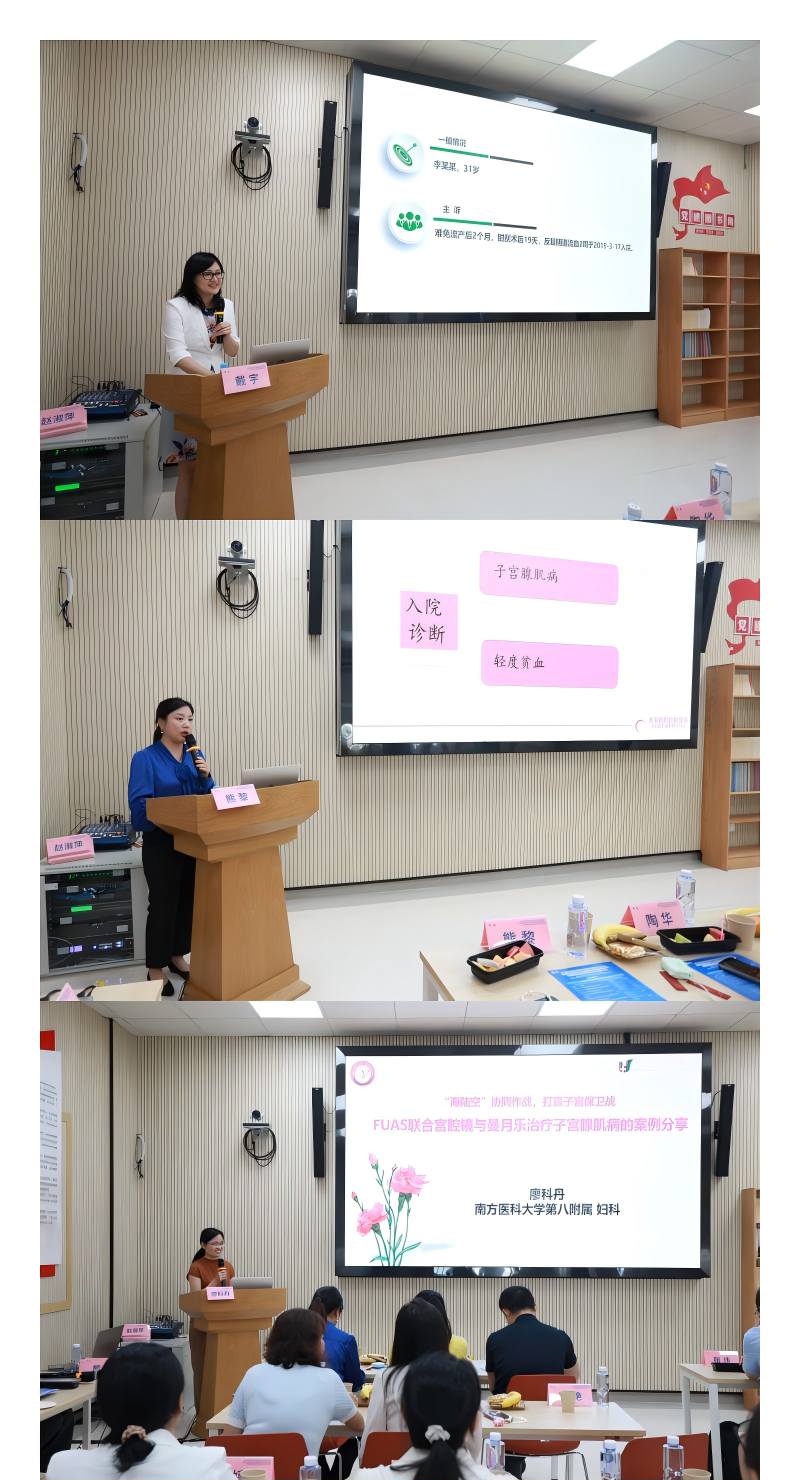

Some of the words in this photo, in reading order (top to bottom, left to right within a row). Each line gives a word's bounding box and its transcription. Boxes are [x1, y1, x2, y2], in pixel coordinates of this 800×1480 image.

[494, 564, 558, 583] 子宫腺肌病
[405, 597, 442, 616] 入院
[408, 622, 446, 644] 诊断
[494, 653, 545, 669] 轻度贫血
[645, 911, 674, 928] 陶华
[529, 1187, 566, 1201] 廖科丹
[474, 1202, 593, 1216] 南方医科大学第八附属
[596, 1202, 621, 1216] 妇科
